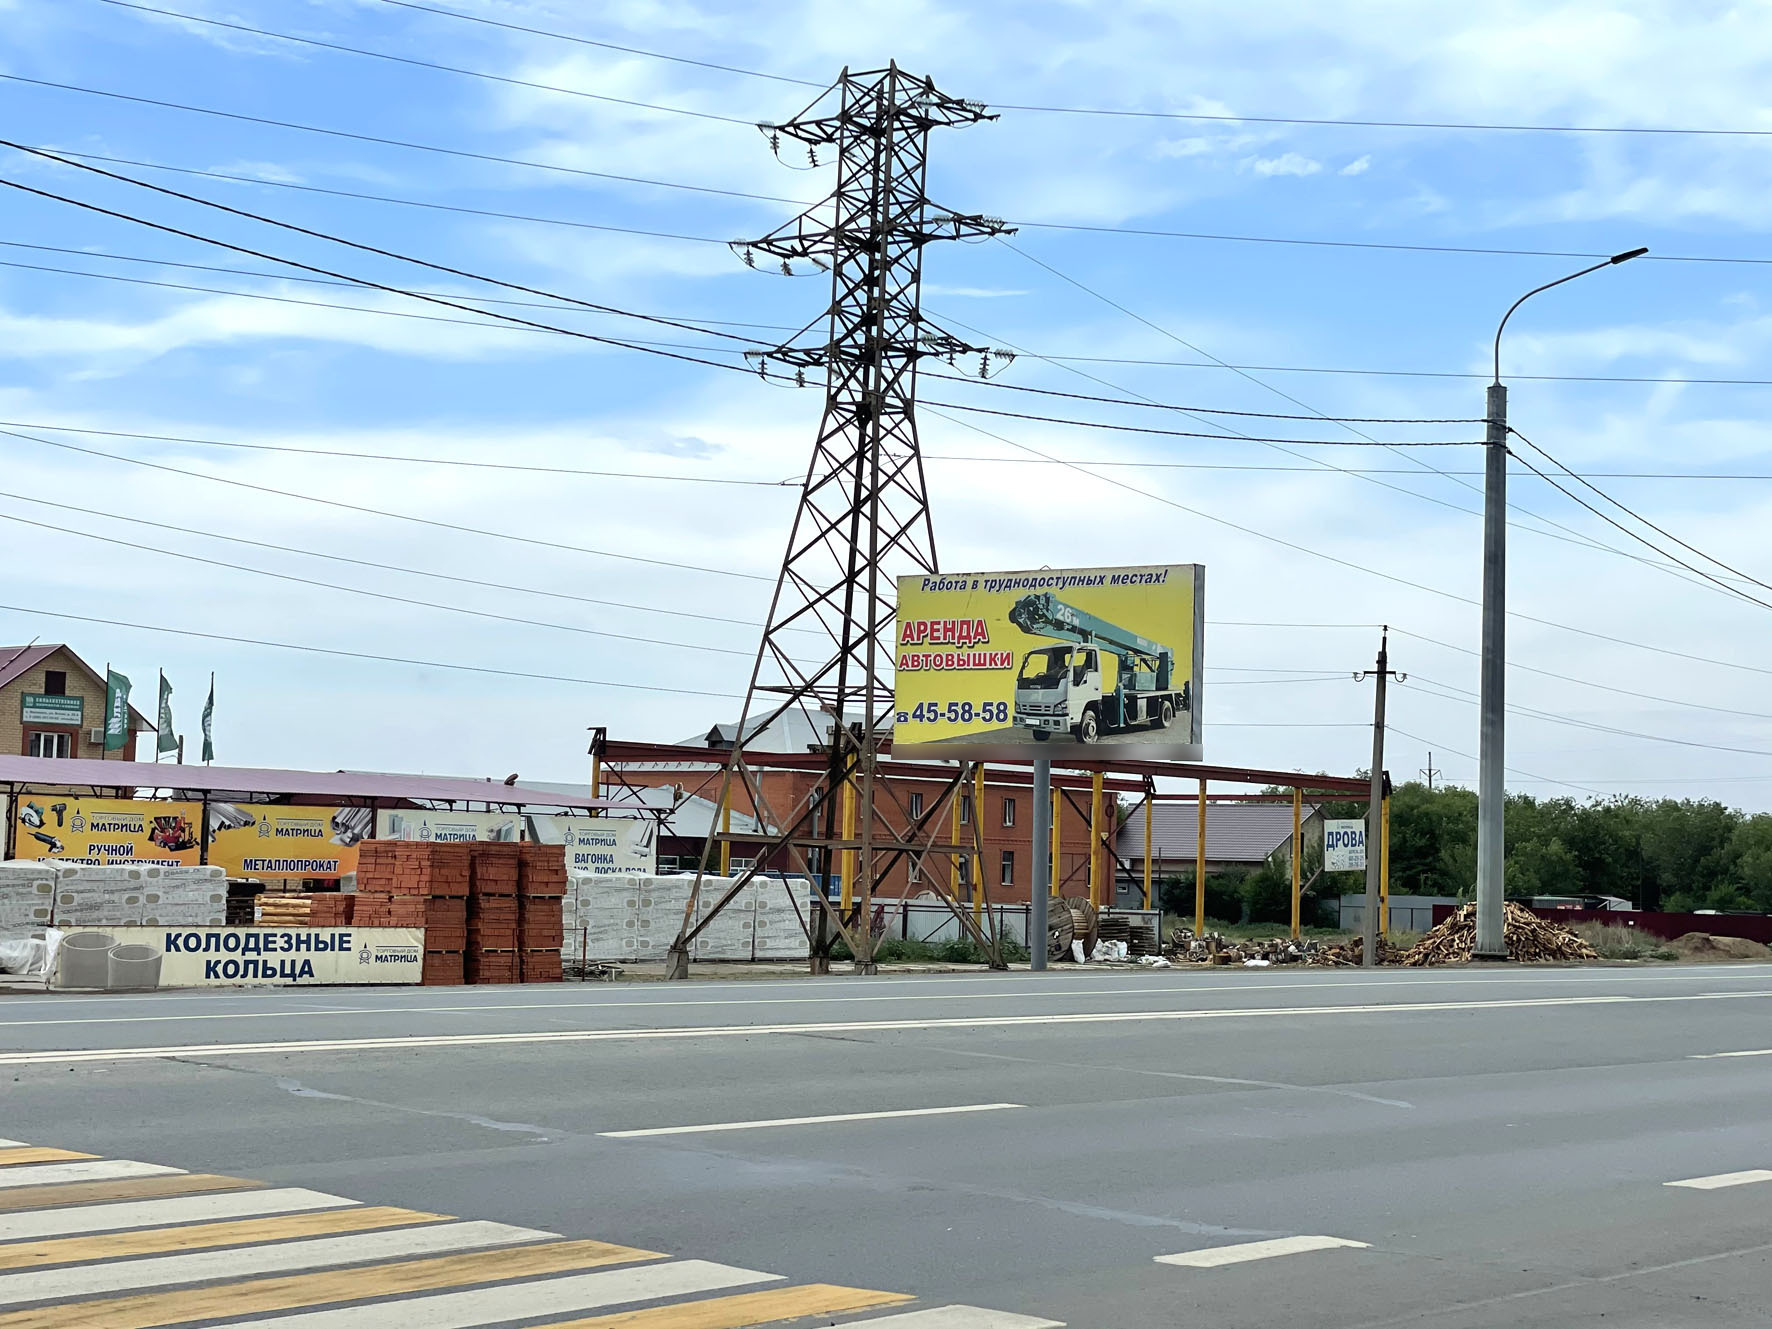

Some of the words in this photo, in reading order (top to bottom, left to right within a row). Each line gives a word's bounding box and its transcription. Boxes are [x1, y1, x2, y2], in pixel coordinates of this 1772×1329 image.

[921, 577, 967, 591] Работа
[971, 580, 979, 590] в
[983, 574, 1106, 592] труднодоступных
[1109, 569, 1168, 585] местах!
[900, 619, 989, 647] АРЕНДА
[898, 651, 1012, 670] АВТОВЫШКИ
[911, 701, 1009, 723] 45-58-58
[90, 822, 144, 833] МАТРИЦА
[275, 828, 323, 838] МАТРИЦА
[435, 832, 477, 842] МАТРИЦА
[578, 837, 617, 847] МАТРИЦА
[1326, 831, 1364, 852] ДРОВА
[88, 842, 134, 857] РУЧНОЙ
[243, 858, 339, 872] МЕТАЛЛОПРОКАТ
[574, 853, 614, 865] ВАГОНКА
[165, 932, 352, 956] КОЛОДЕЗНЫЕ
[375, 954, 418, 963] МАТРИЦА
[204, 959, 315, 982] КОЛЬЦА
